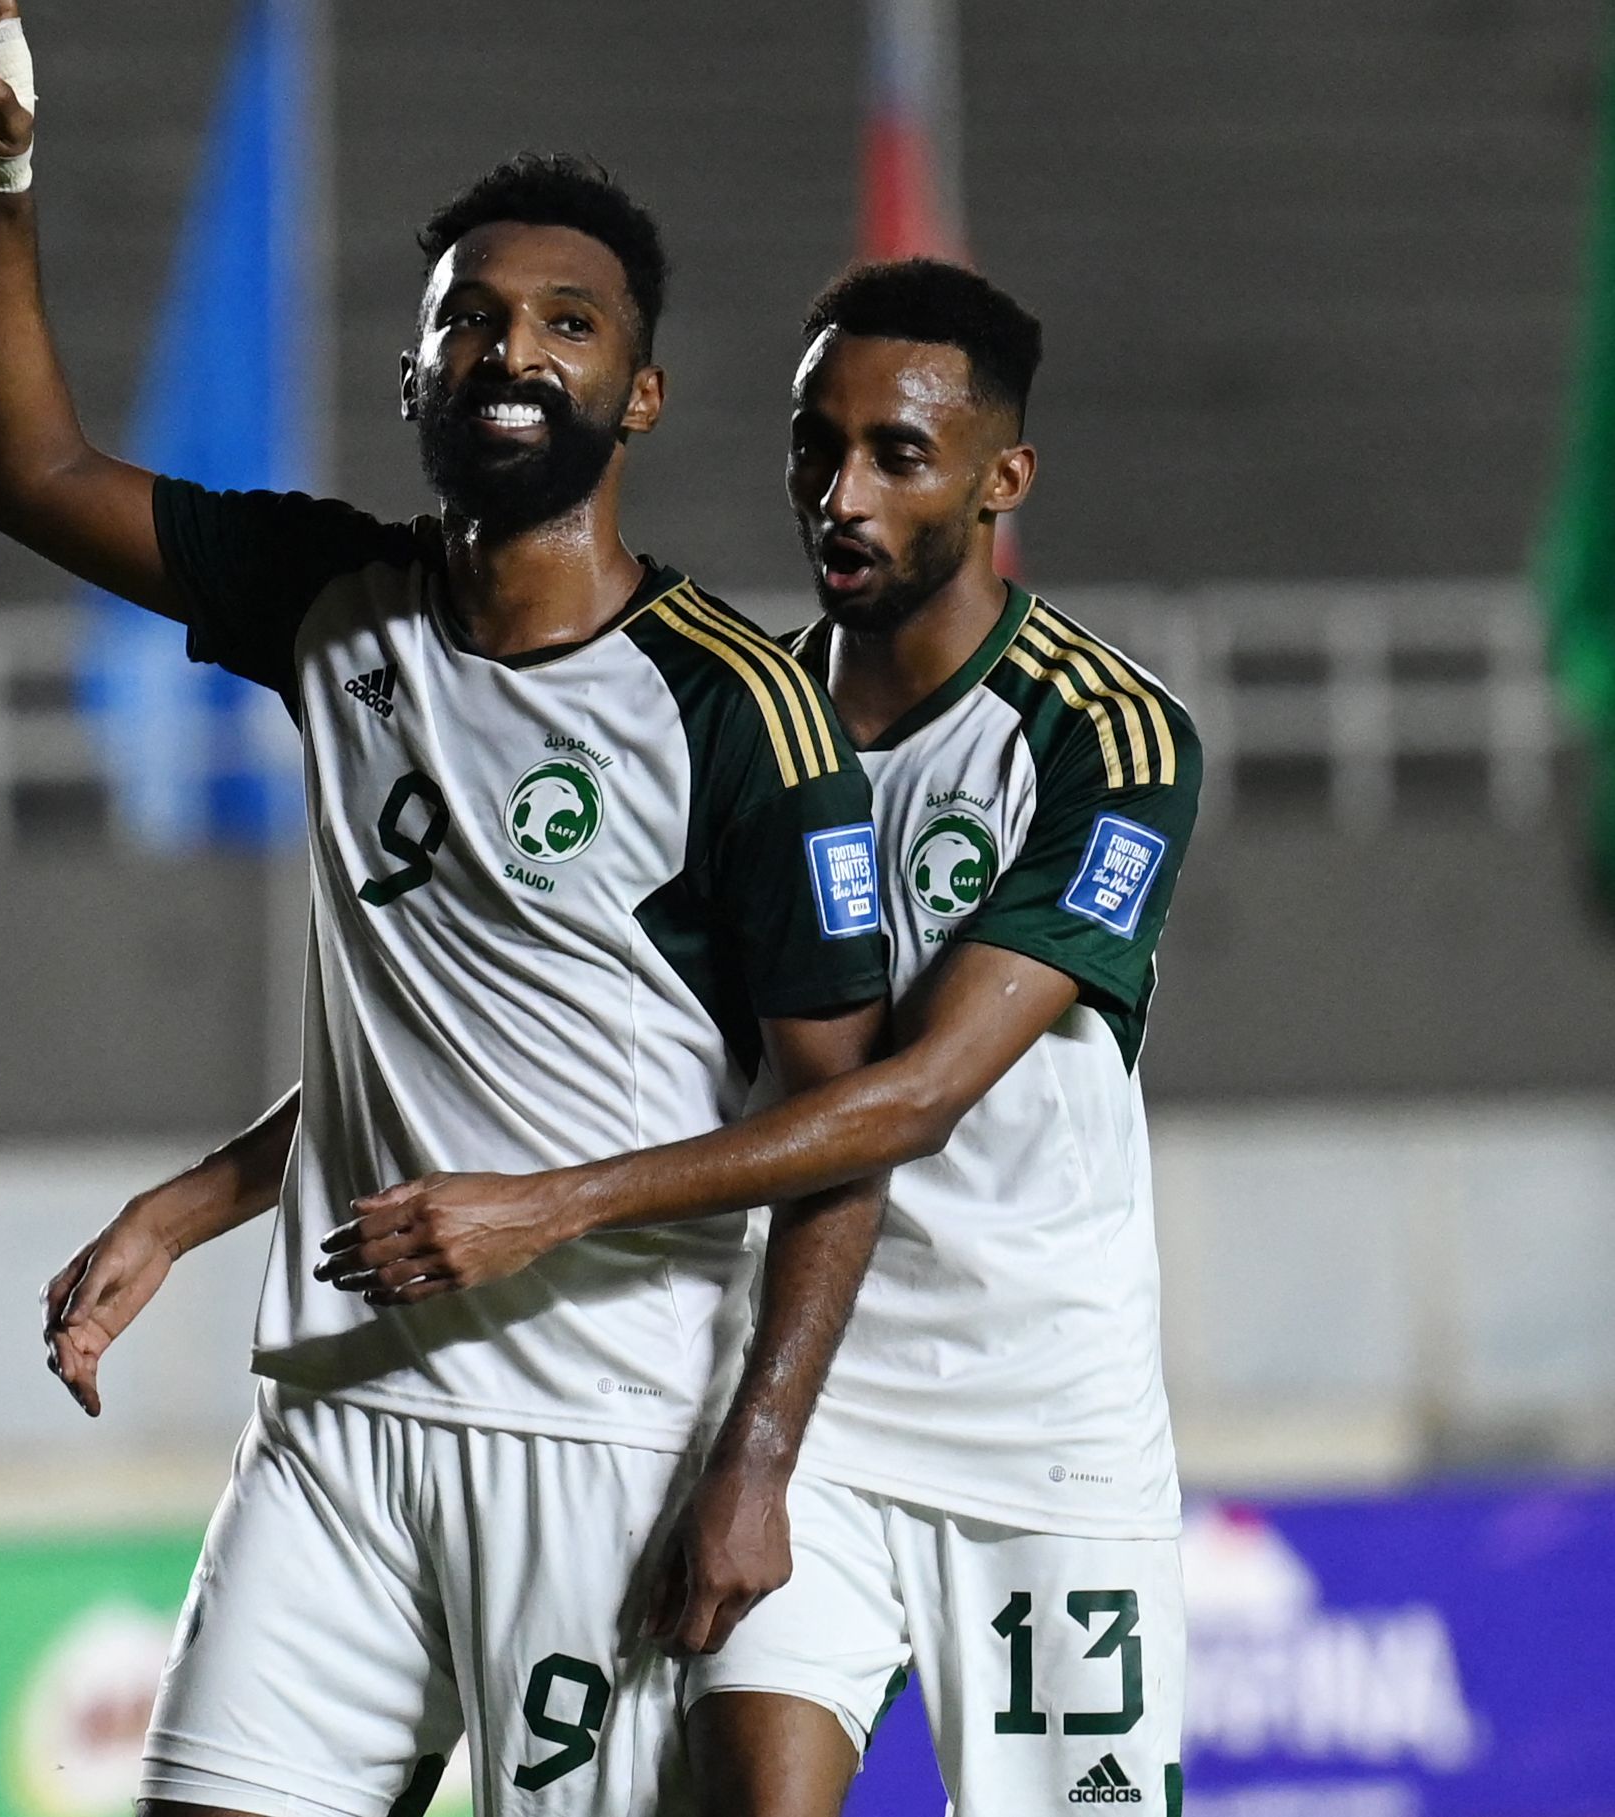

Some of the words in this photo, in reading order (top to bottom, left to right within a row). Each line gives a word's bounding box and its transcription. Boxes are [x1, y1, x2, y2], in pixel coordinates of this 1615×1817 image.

[344, 679, 394, 718] adidas
[544, 732, 614, 770] السعودية
[358, 770, 449, 907] 9
[548, 822, 577, 840] SAFF
[827, 841, 869, 863] FOOTBALL
[1103, 848, 1147, 882] UNITES
[1111, 833, 1153, 865] FOOTBALL
[503, 863, 555, 893] SAUDI
[830, 857, 871, 882] UNITES
[953, 876, 982, 887] SAFF
[990, 1590, 1144, 1735] 13
[513, 1652, 611, 1792] 9
[1068, 1785, 1142, 1803] adidas
